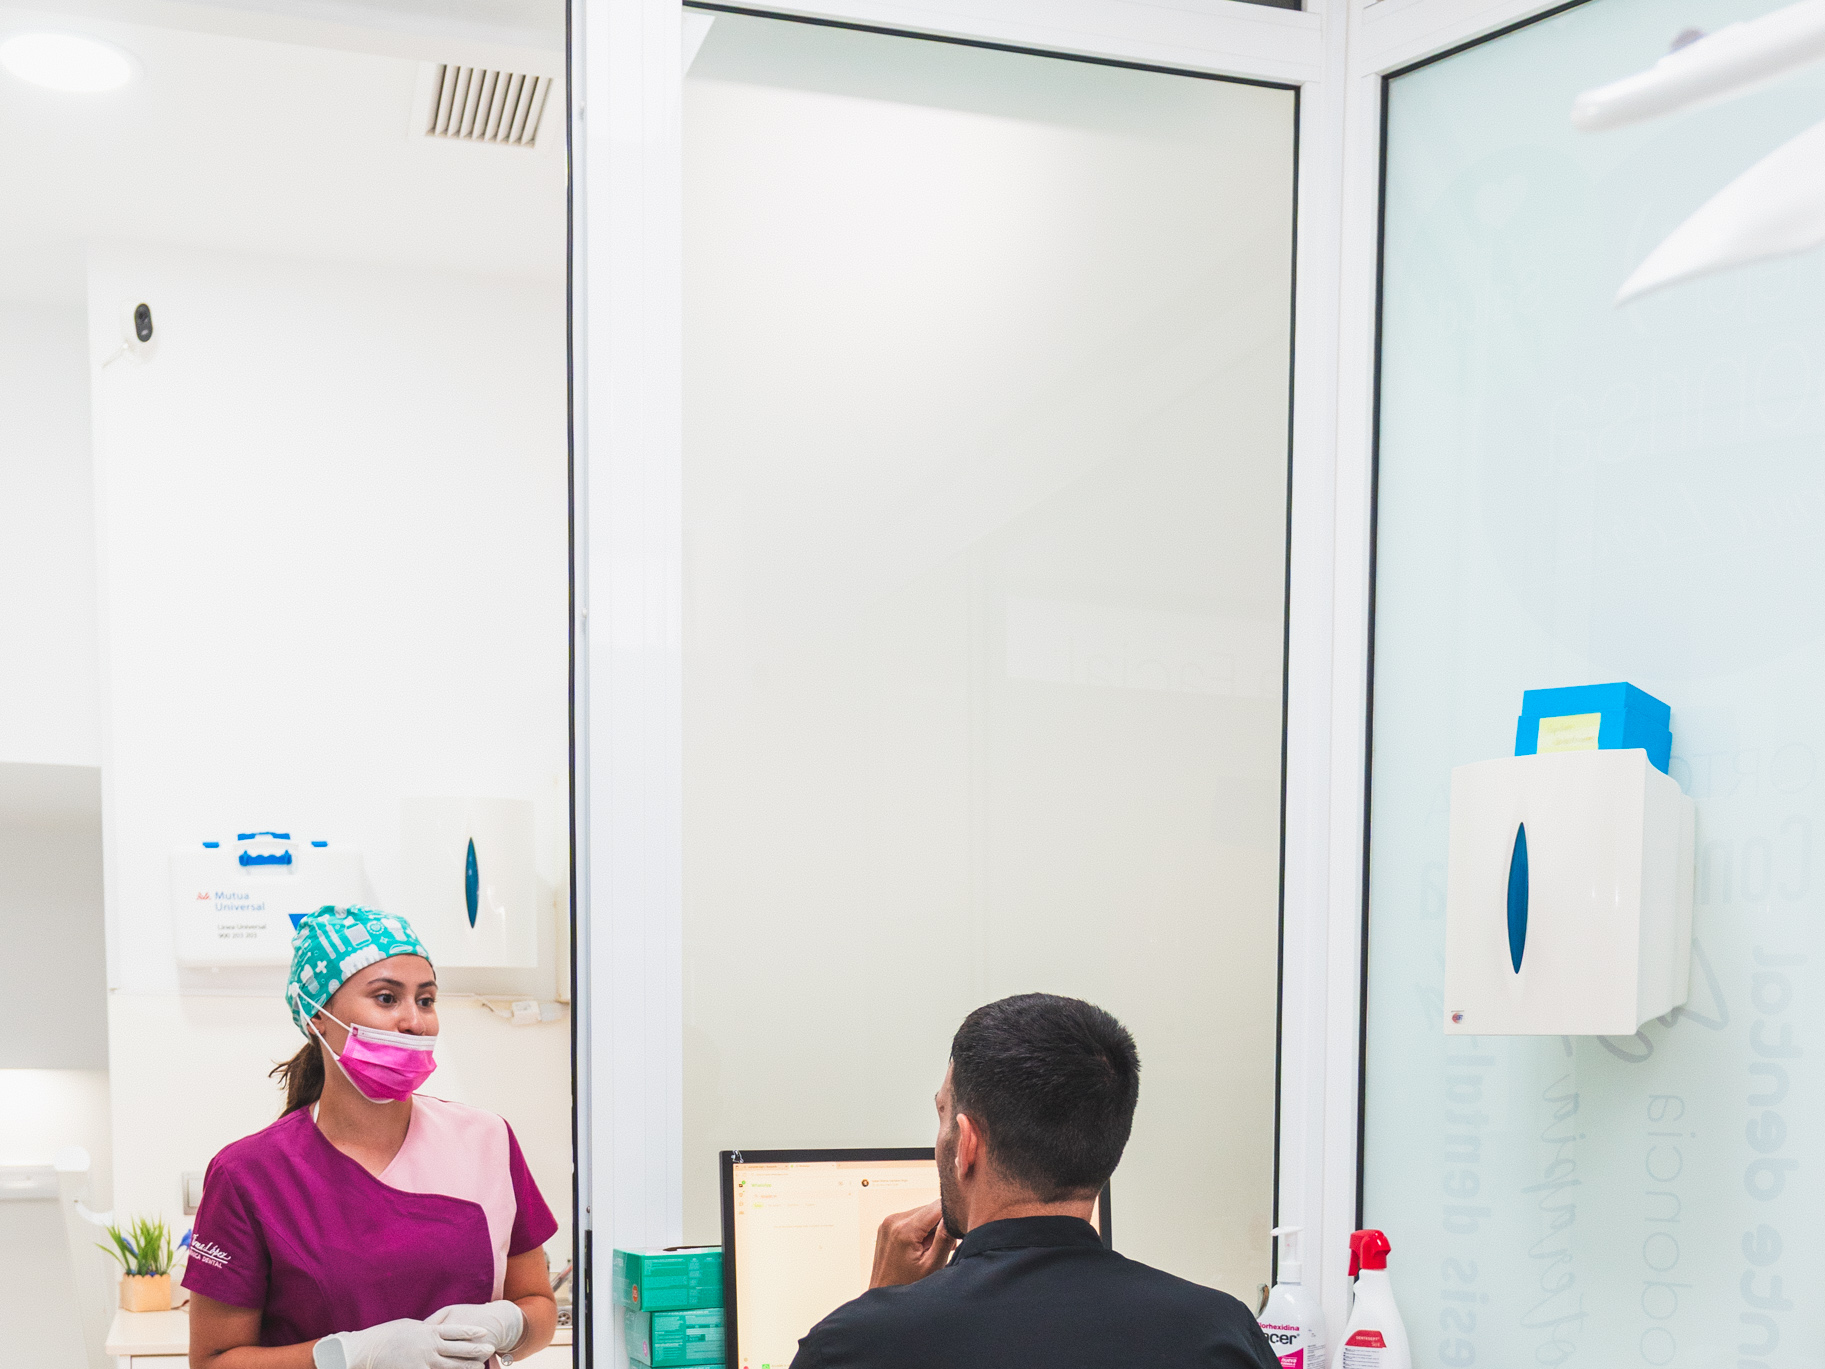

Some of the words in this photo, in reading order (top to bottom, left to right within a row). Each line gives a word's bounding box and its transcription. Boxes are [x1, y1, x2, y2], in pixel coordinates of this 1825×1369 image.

[215, 891, 249, 900] Mutua
[215, 902, 266, 911] Universal
[202, 1256, 222, 1269] DENTAL
[1258, 1322, 1300, 1331] lorhexidina
